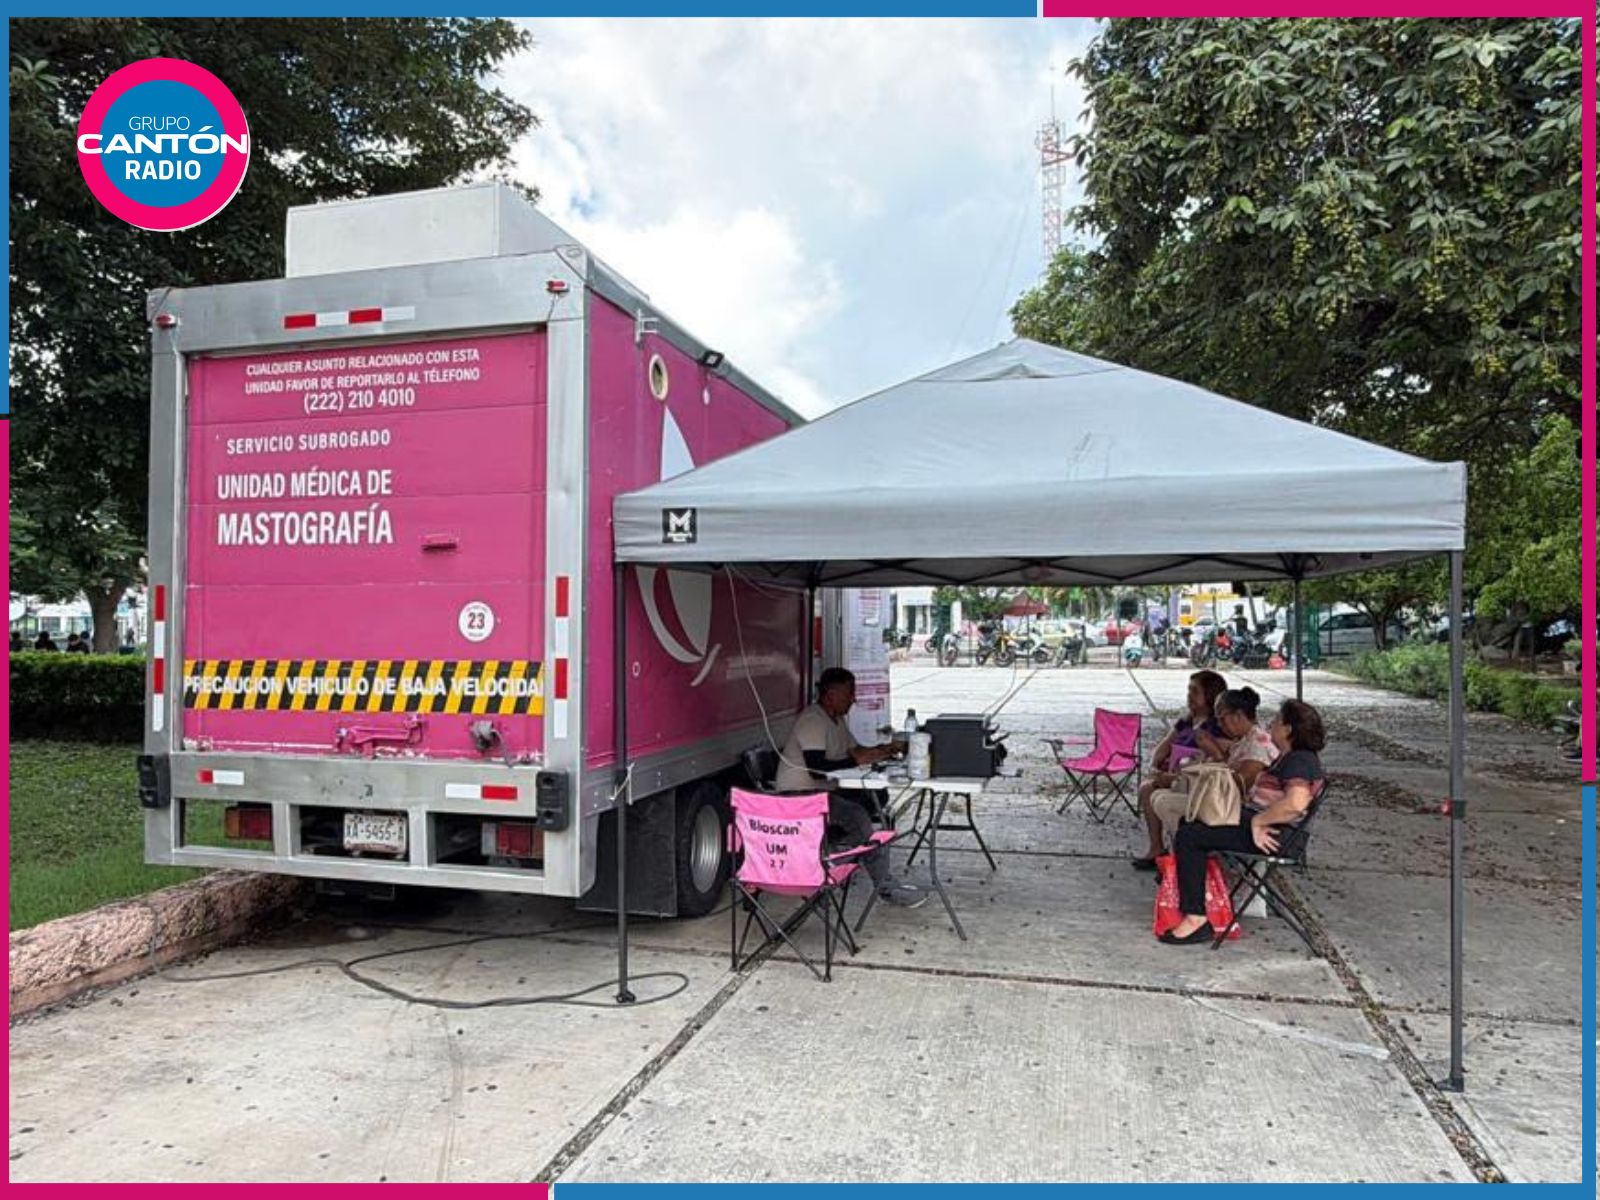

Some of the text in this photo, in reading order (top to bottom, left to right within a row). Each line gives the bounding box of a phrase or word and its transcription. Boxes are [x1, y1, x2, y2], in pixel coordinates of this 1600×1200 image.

[246, 348, 480, 376] CUALQUIER ASUNTO RELACIONADO CON ESTA
[245, 366, 480, 394] UNIDAD FAVOR DE REPORTARLO AL TÉLEFONO
[303, 387, 415, 415] (222) 210 4010
[227, 429, 391, 455] SERVICIO SUBROGADO
[217, 465, 393, 499] UNIDAD MÉDICA DE
[217, 503, 393, 546] MASTOGRAFÍA
[467, 612, 485, 630] 23
[184, 675, 544, 696] PRECAUCION VEHICULO DE BAJA VELOCIDA
[766, 843, 788, 855] UM
